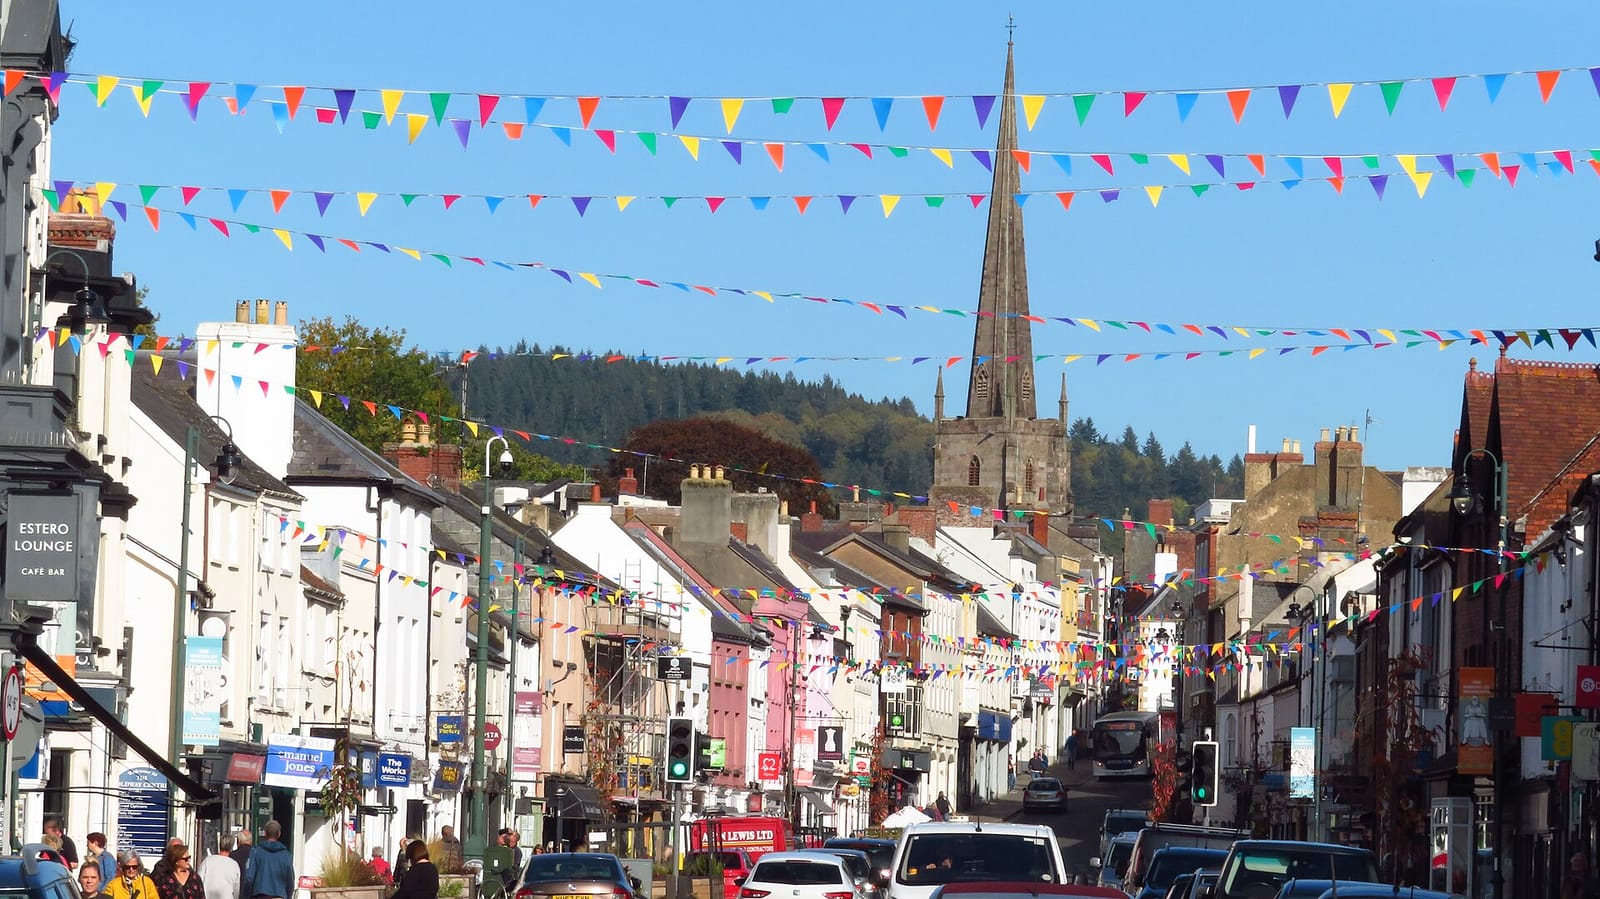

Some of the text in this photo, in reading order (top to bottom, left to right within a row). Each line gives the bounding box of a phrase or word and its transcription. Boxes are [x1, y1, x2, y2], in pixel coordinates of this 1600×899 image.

[20, 523, 69, 534] ESTERO
[15, 540, 73, 552] LOUNGE
[48, 568, 65, 576] BAR
[278, 751, 323, 762] emanuel
[387, 758, 402, 767] The
[381, 765, 407, 775] Works
[702, 830, 773, 842] AN LEWIS LTD
